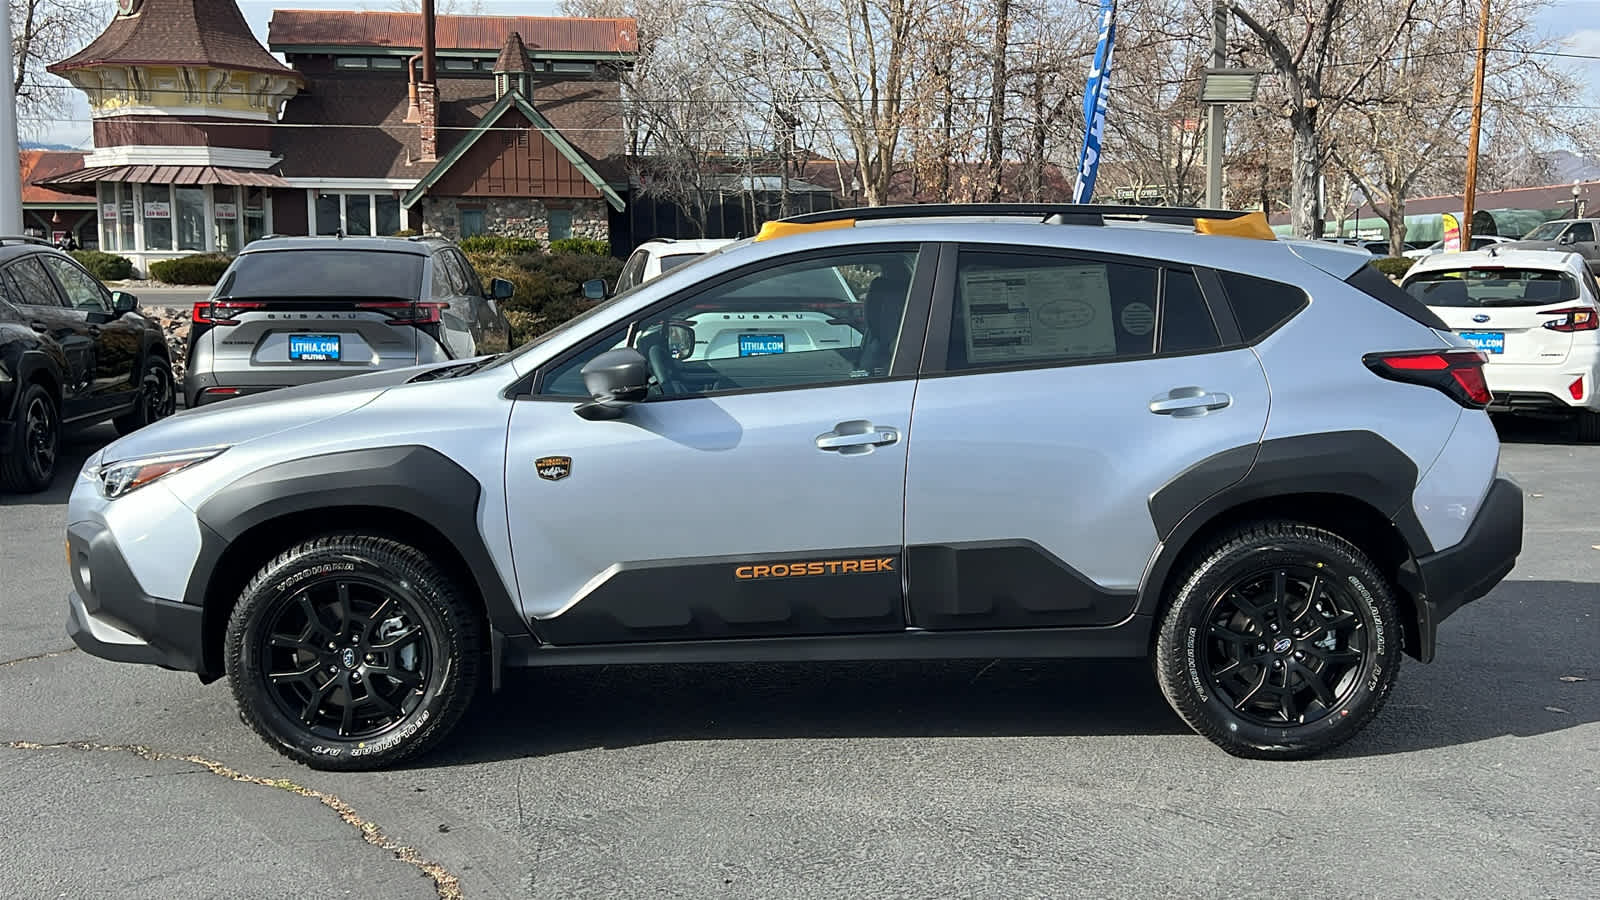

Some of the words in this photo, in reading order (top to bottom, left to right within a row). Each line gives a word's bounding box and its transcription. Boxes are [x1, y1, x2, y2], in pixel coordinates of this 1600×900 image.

[291, 342, 339, 353] LITHIA.COM
[741, 341, 784, 350] LITHIA.COM
[276, 562, 355, 592] YOKOHAMA
[735, 557, 895, 580] CROSSTREK
